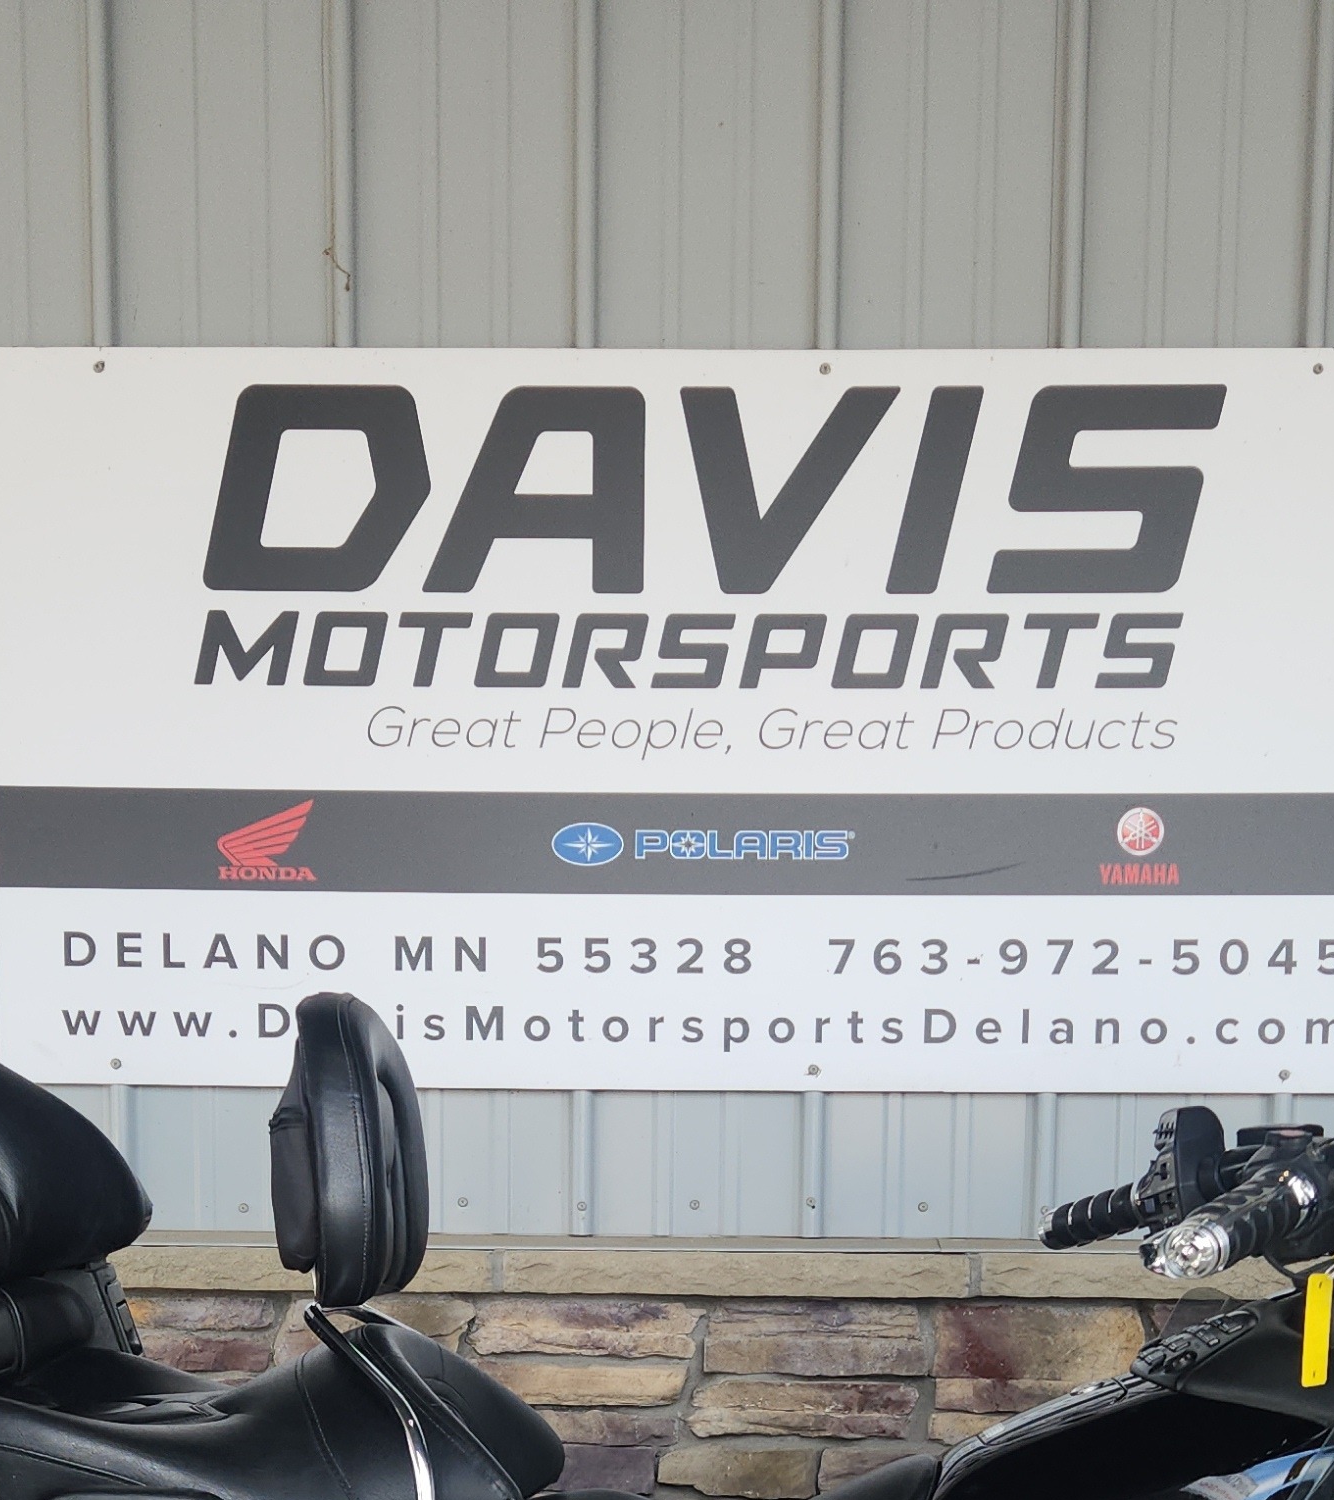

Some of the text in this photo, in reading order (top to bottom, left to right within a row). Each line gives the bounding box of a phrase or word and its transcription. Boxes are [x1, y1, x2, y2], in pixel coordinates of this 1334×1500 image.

[203, 384, 1227, 594] DAVIS
[194, 610, 1184, 689] MOTORSPORTS
[366, 705, 1179, 761] Great People, Great Products
[218, 866, 317, 881] HONDA
[1099, 862, 1180, 886] YAMAHA
[63, 931, 346, 971] DELANO
[394, 935, 487, 972] MN
[536, 937, 752, 975] 55328
